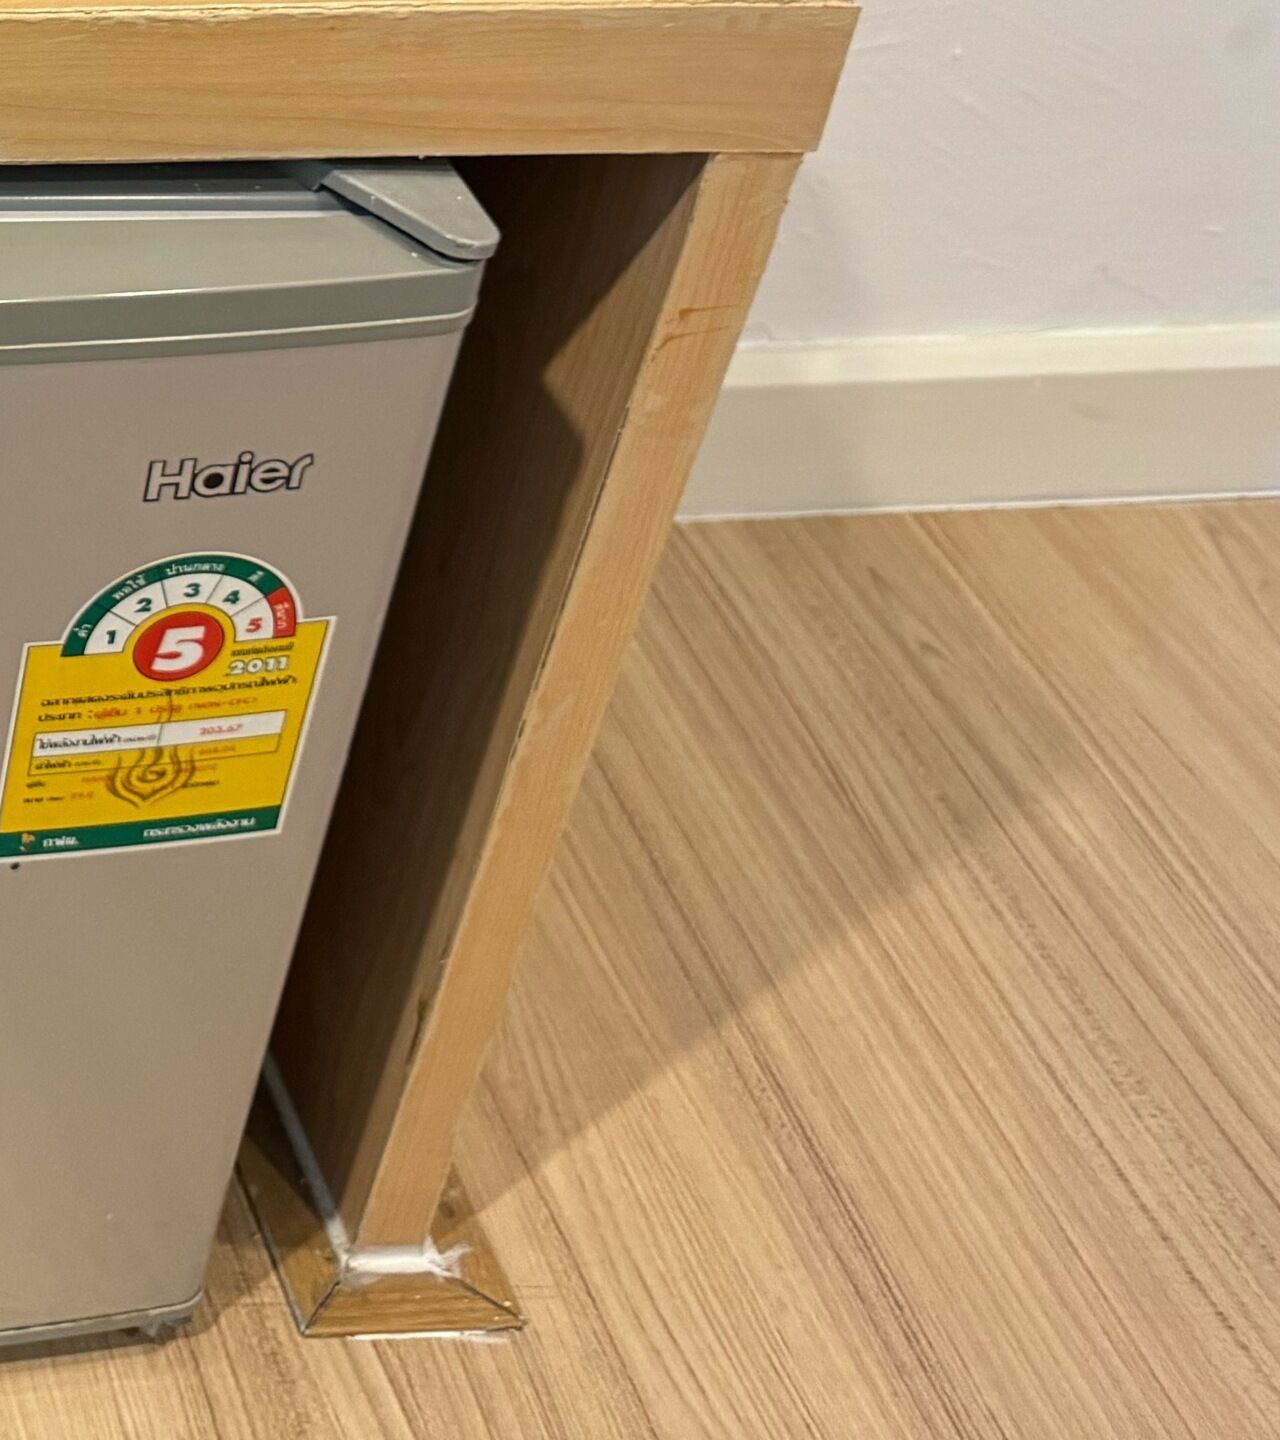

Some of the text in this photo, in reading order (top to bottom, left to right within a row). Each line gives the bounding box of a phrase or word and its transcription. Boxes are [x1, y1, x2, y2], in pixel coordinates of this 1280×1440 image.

[143, 450, 315, 502] Haier
[183, 582, 202, 598] 3
[222, 589, 241, 605] 4
[134, 597, 152, 613] 2
[245, 617, 263, 633] 5
[106, 629, 117, 645] 1
[150, 625, 206, 672] 5
[227, 654, 291, 676] 2011
